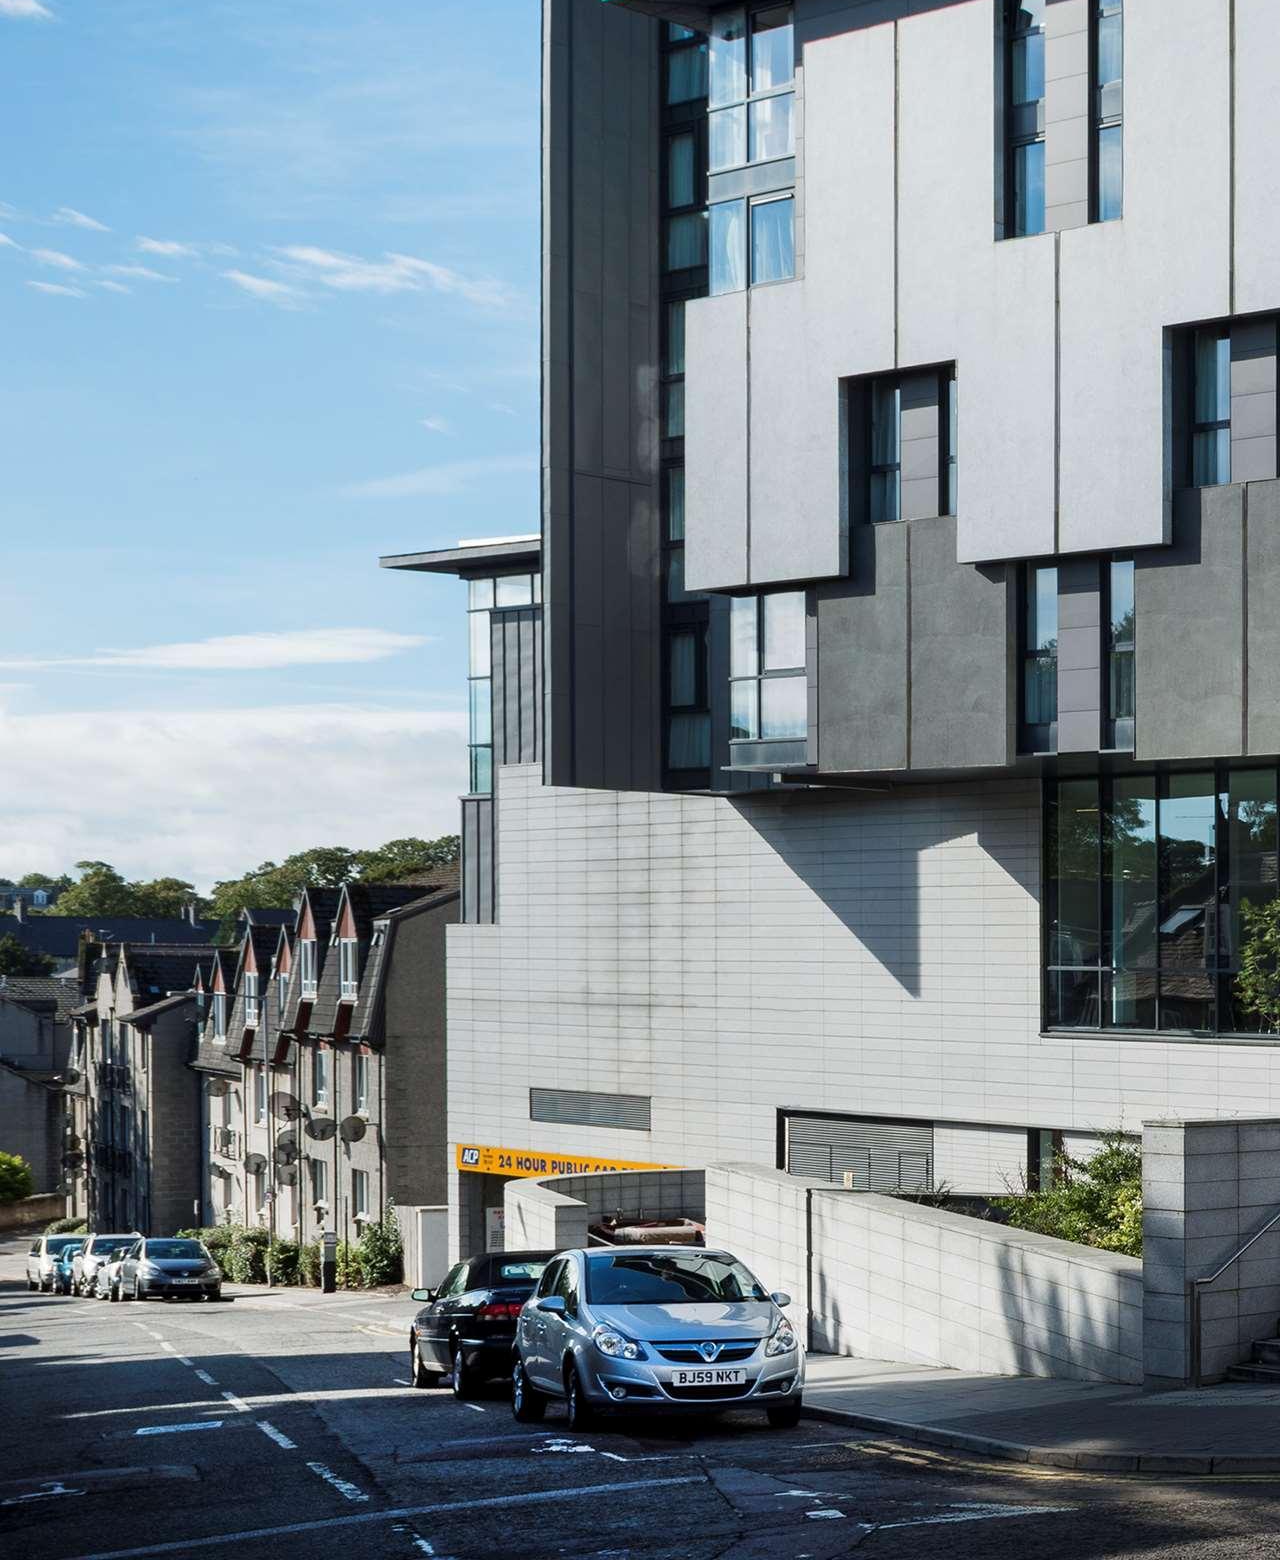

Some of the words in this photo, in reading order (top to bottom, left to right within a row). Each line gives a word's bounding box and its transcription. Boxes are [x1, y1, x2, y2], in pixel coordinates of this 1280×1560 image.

[462, 1148, 479, 1164] ACP
[498, 1154, 512, 1169] 24
[516, 1156, 547, 1173] HOUR
[551, 1159, 590, 1175] PUBLIC
[678, 1371, 713, 1384] BJ59
[716, 1370, 741, 1383] NKT
